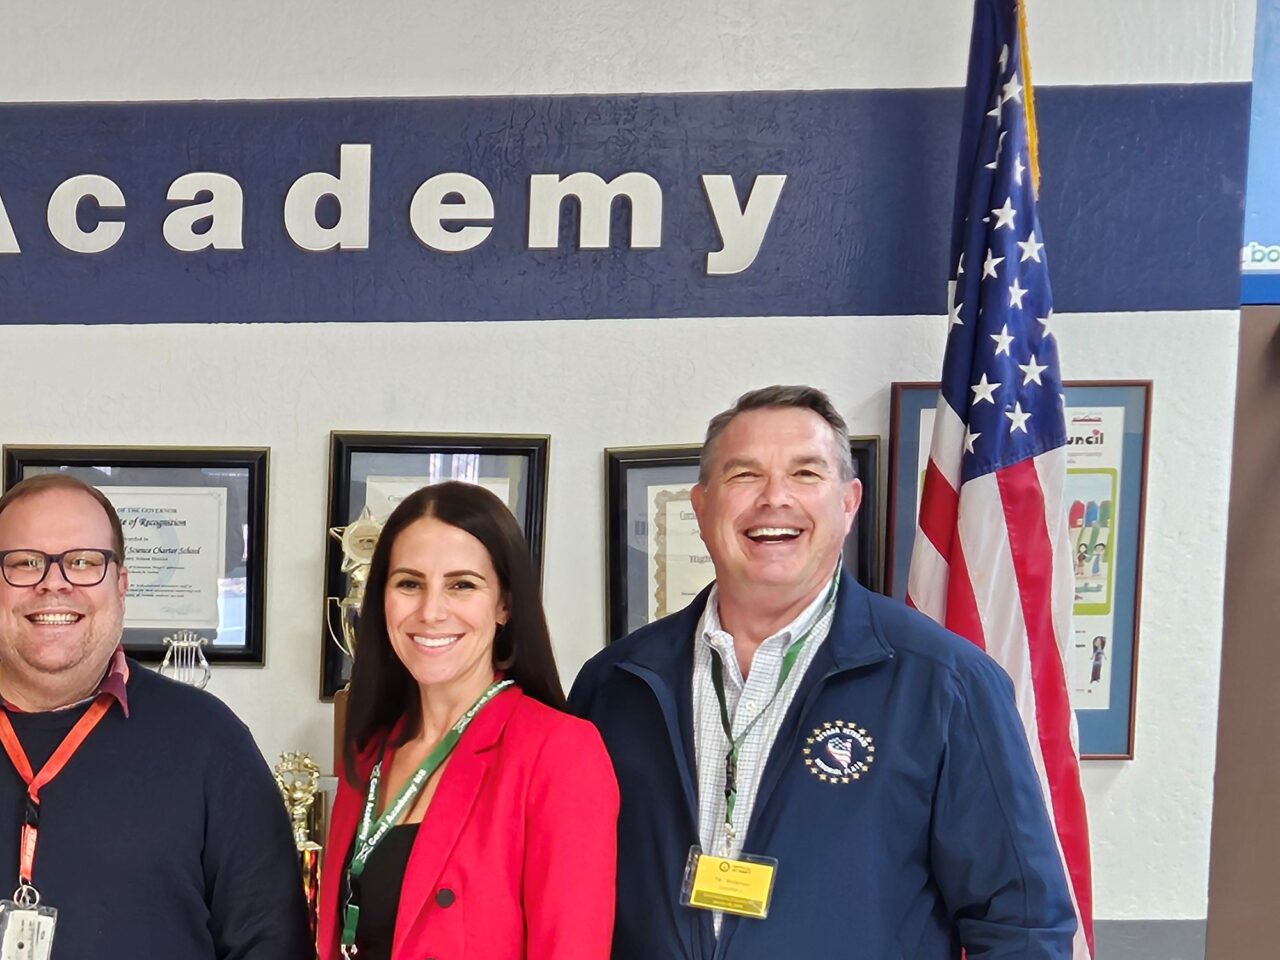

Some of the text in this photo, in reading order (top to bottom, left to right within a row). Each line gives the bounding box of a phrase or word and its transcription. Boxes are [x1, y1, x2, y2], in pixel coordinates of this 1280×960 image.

[129, 517, 140, 528] of
[139, 518, 186, 529] Recognition
[152, 546, 178, 554] Charter
[178, 546, 201, 555] School
[368, 824, 387, 846] Coral
[386, 785, 416, 823] Academy
